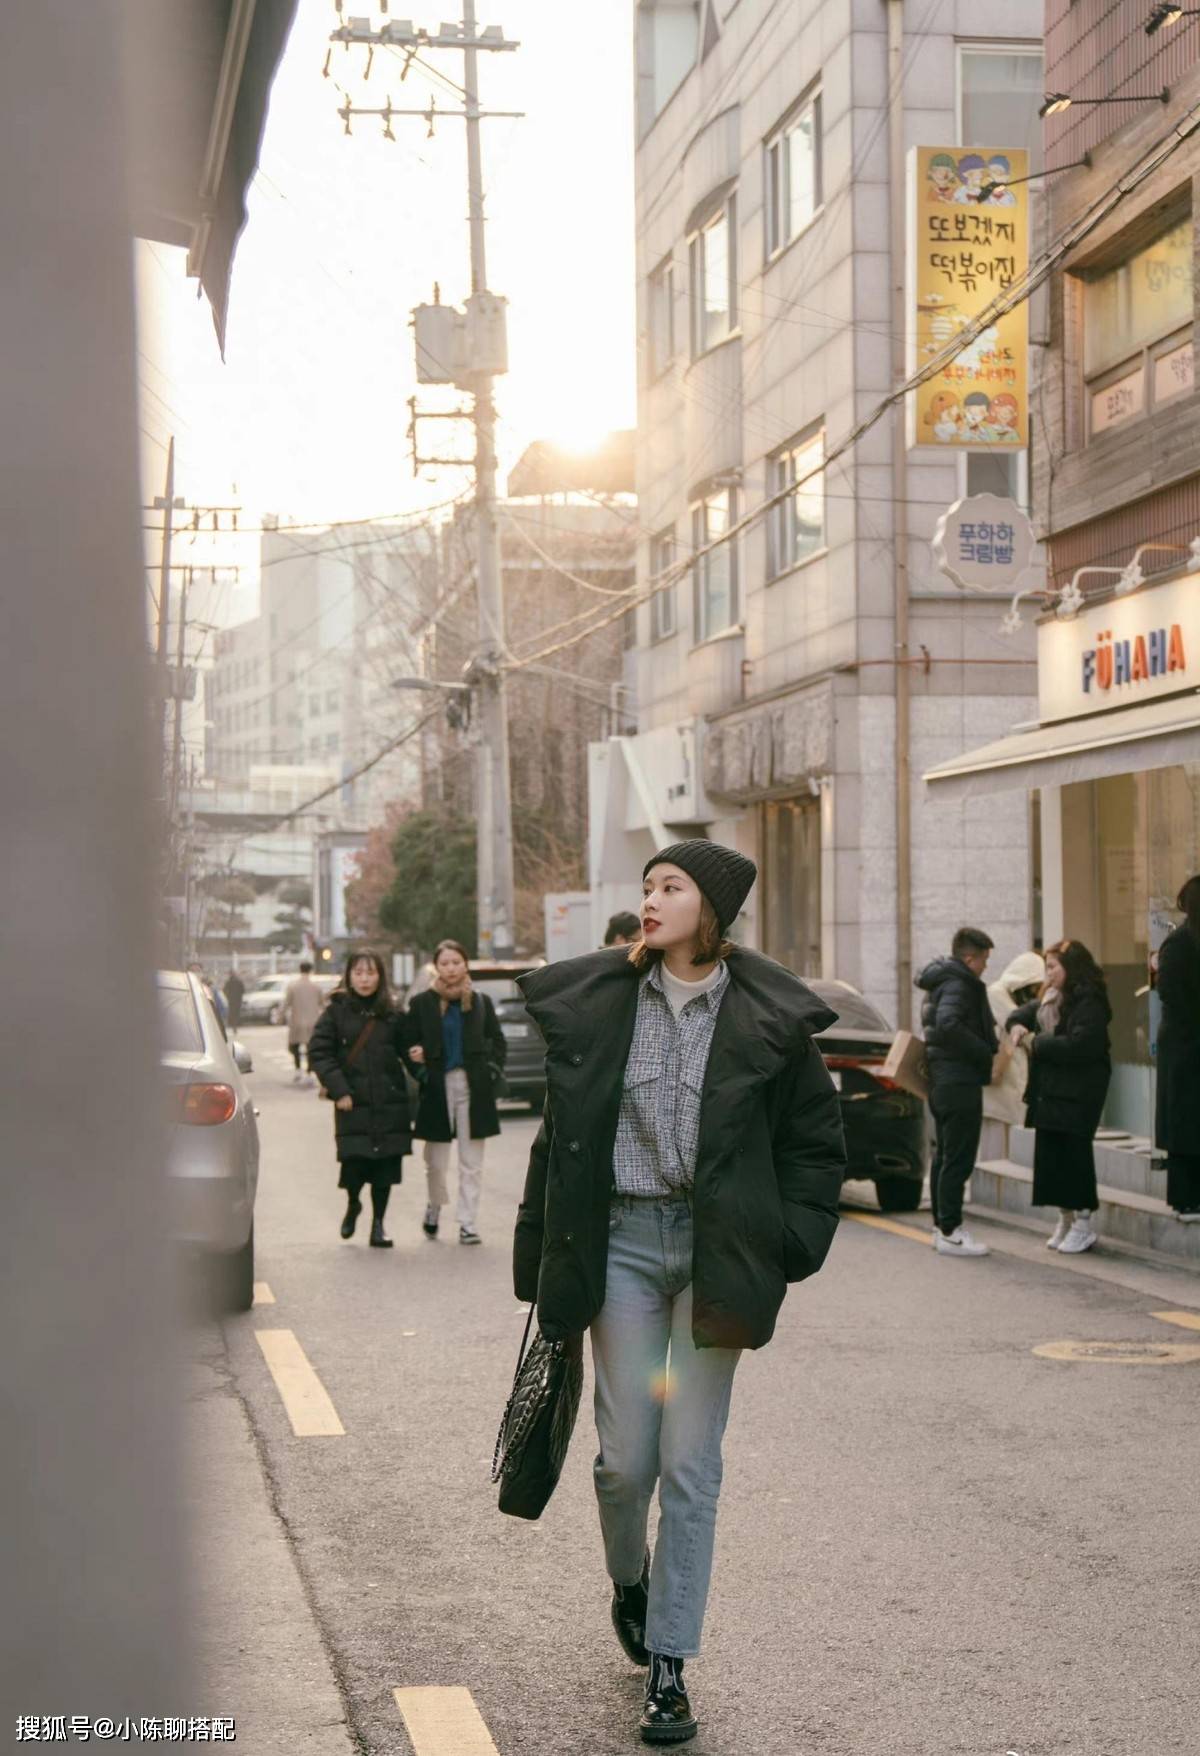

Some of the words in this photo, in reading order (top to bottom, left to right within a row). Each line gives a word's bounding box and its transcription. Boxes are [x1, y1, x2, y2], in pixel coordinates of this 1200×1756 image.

[929, 213, 1016, 246] 또보겠지
[929, 252, 1016, 292] 떡볶이집
[958, 521, 1016, 543] 푸하하
[958, 543, 1016, 565] 크림빵
[1082, 624, 1186, 694] FÜHAHA
